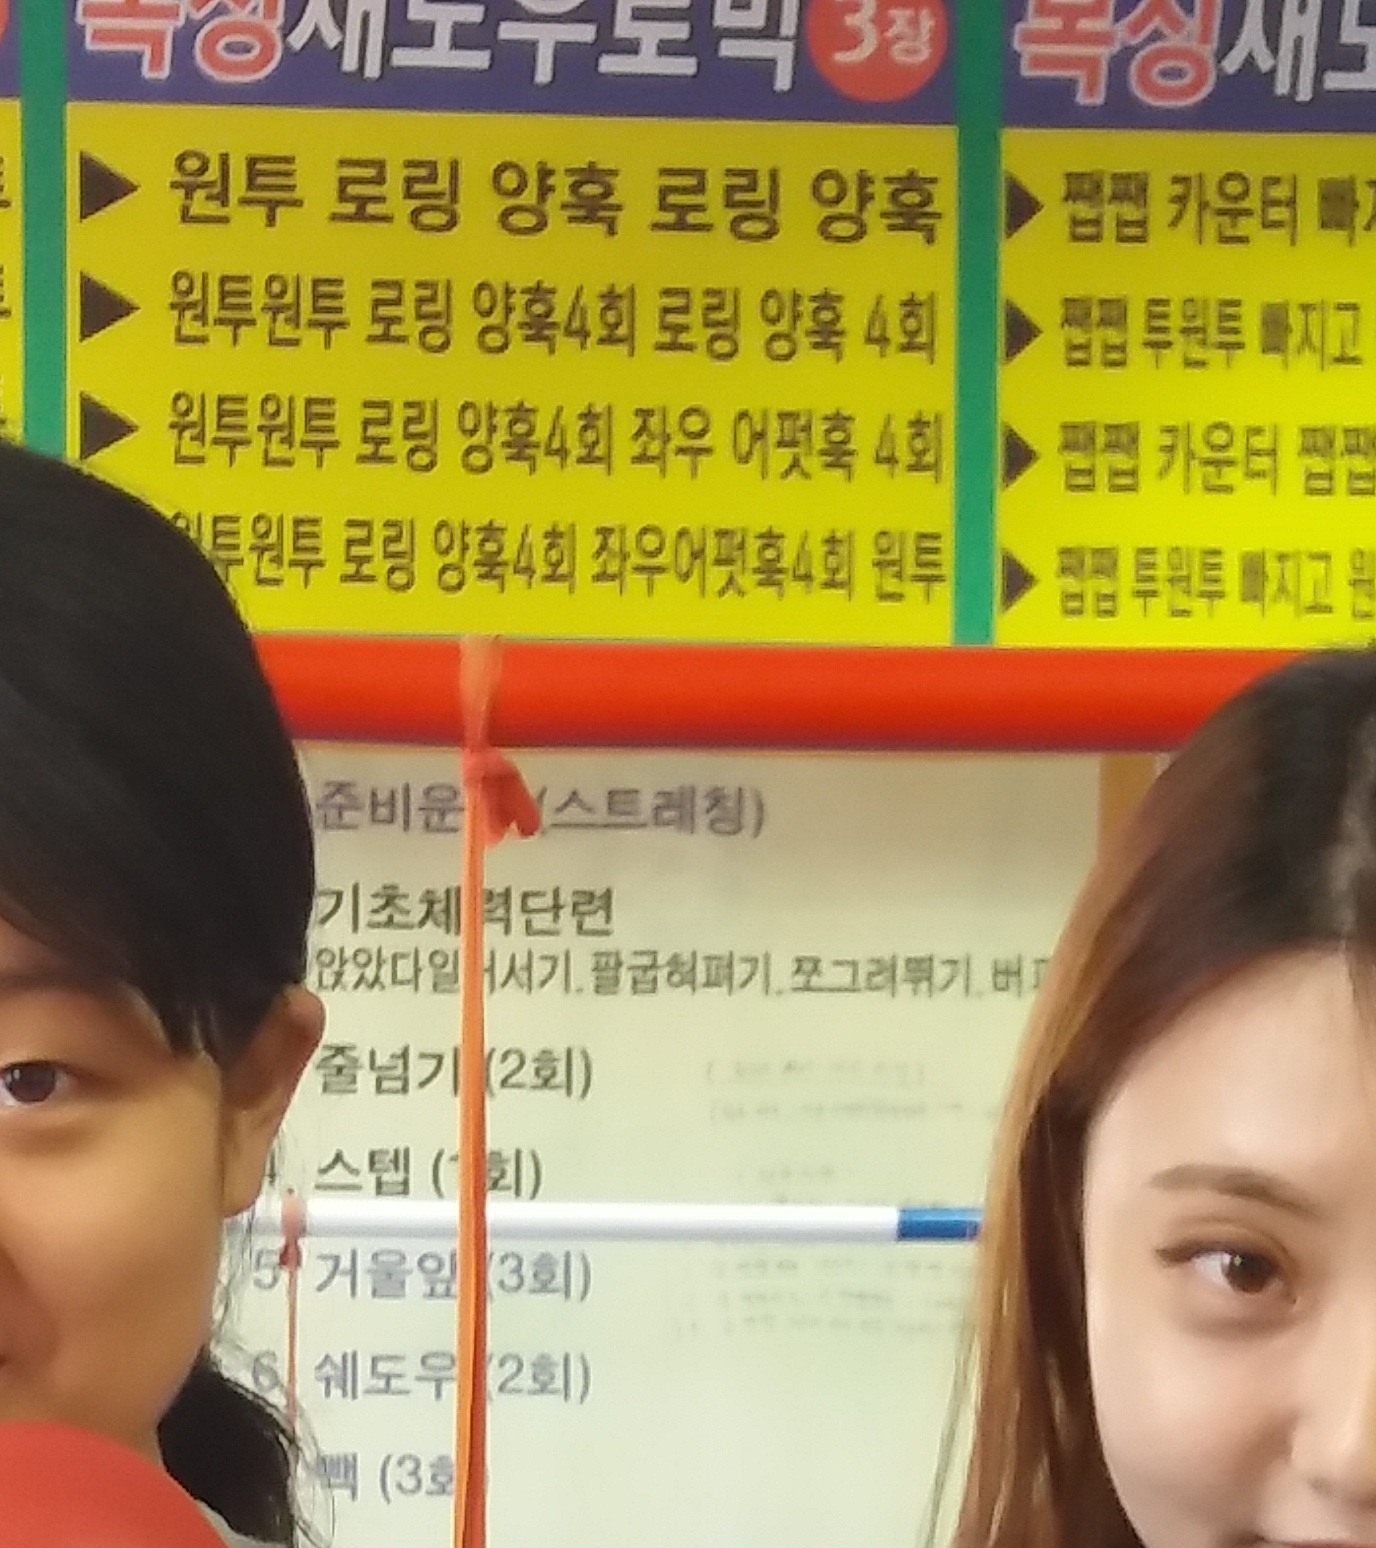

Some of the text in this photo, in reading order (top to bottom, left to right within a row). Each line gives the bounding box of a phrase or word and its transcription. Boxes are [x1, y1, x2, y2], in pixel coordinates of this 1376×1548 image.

[834, 0, 937, 64] 3장
[169, 149, 943, 246] 원투 로링 양훅 로링 양훅
[168, 269, 936, 365] 원투원투 로링 양훅4회 로링 양훅 4회
[167, 391, 342, 469] 원투원투
[355, 398, 439, 473] 로링
[457, 399, 614, 476] 양훅4회
[630, 405, 715, 477] 좌우
[873, 410, 943, 484] 4회
[339, 518, 416, 593] 로링
[432, 518, 577, 594] 양훅4회
[871, 529, 953, 602] 원투
[315, 1043, 594, 1100] 줄넘기 (2회)
[313, 1146, 411, 1197] 스텝
[315, 1247, 592, 1302] 거울앞 (3회)
[313, 1349, 592, 1405] 쉐도우 (2회)
